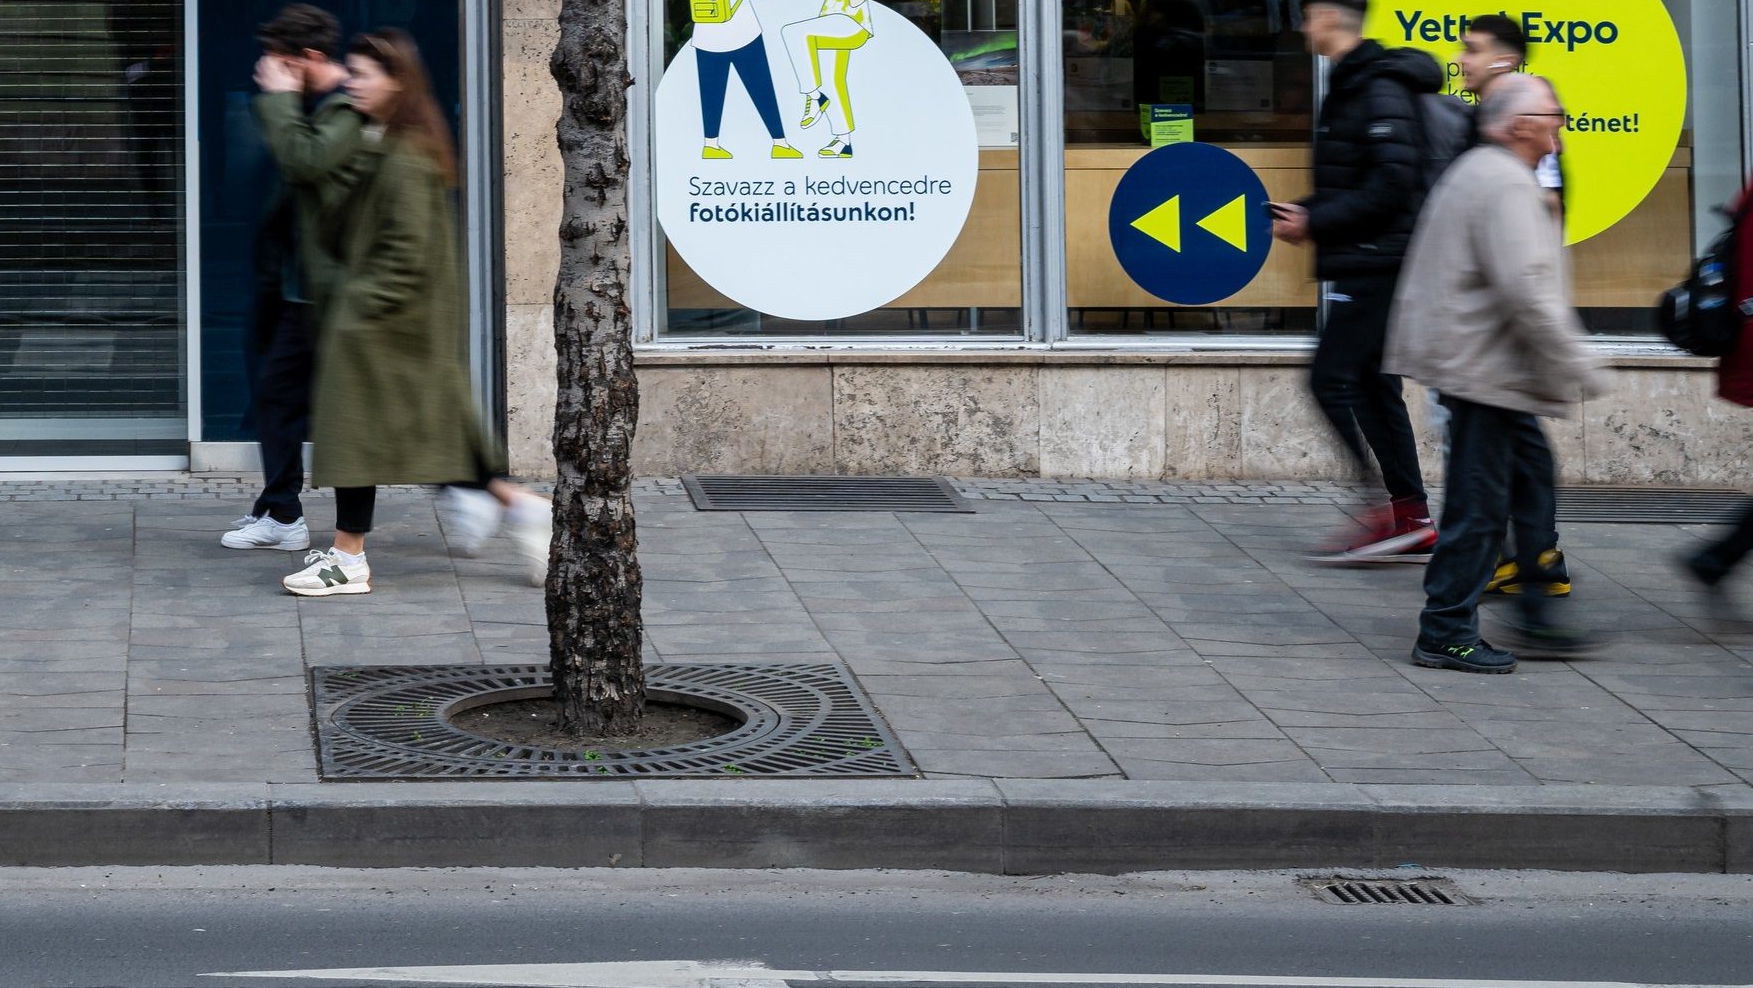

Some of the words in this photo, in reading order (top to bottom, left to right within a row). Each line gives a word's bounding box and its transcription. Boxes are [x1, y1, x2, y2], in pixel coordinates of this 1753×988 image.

[1394, 10, 1508, 43] Yett
[1522, 11, 1619, 52] Expo
[1564, 113, 1639, 133] ténet!
[689, 176, 775, 196] Szavazz
[783, 181, 796, 196] a
[805, 175, 952, 195] kedvencedre
[690, 201, 915, 222] fotókiállításunkon!
